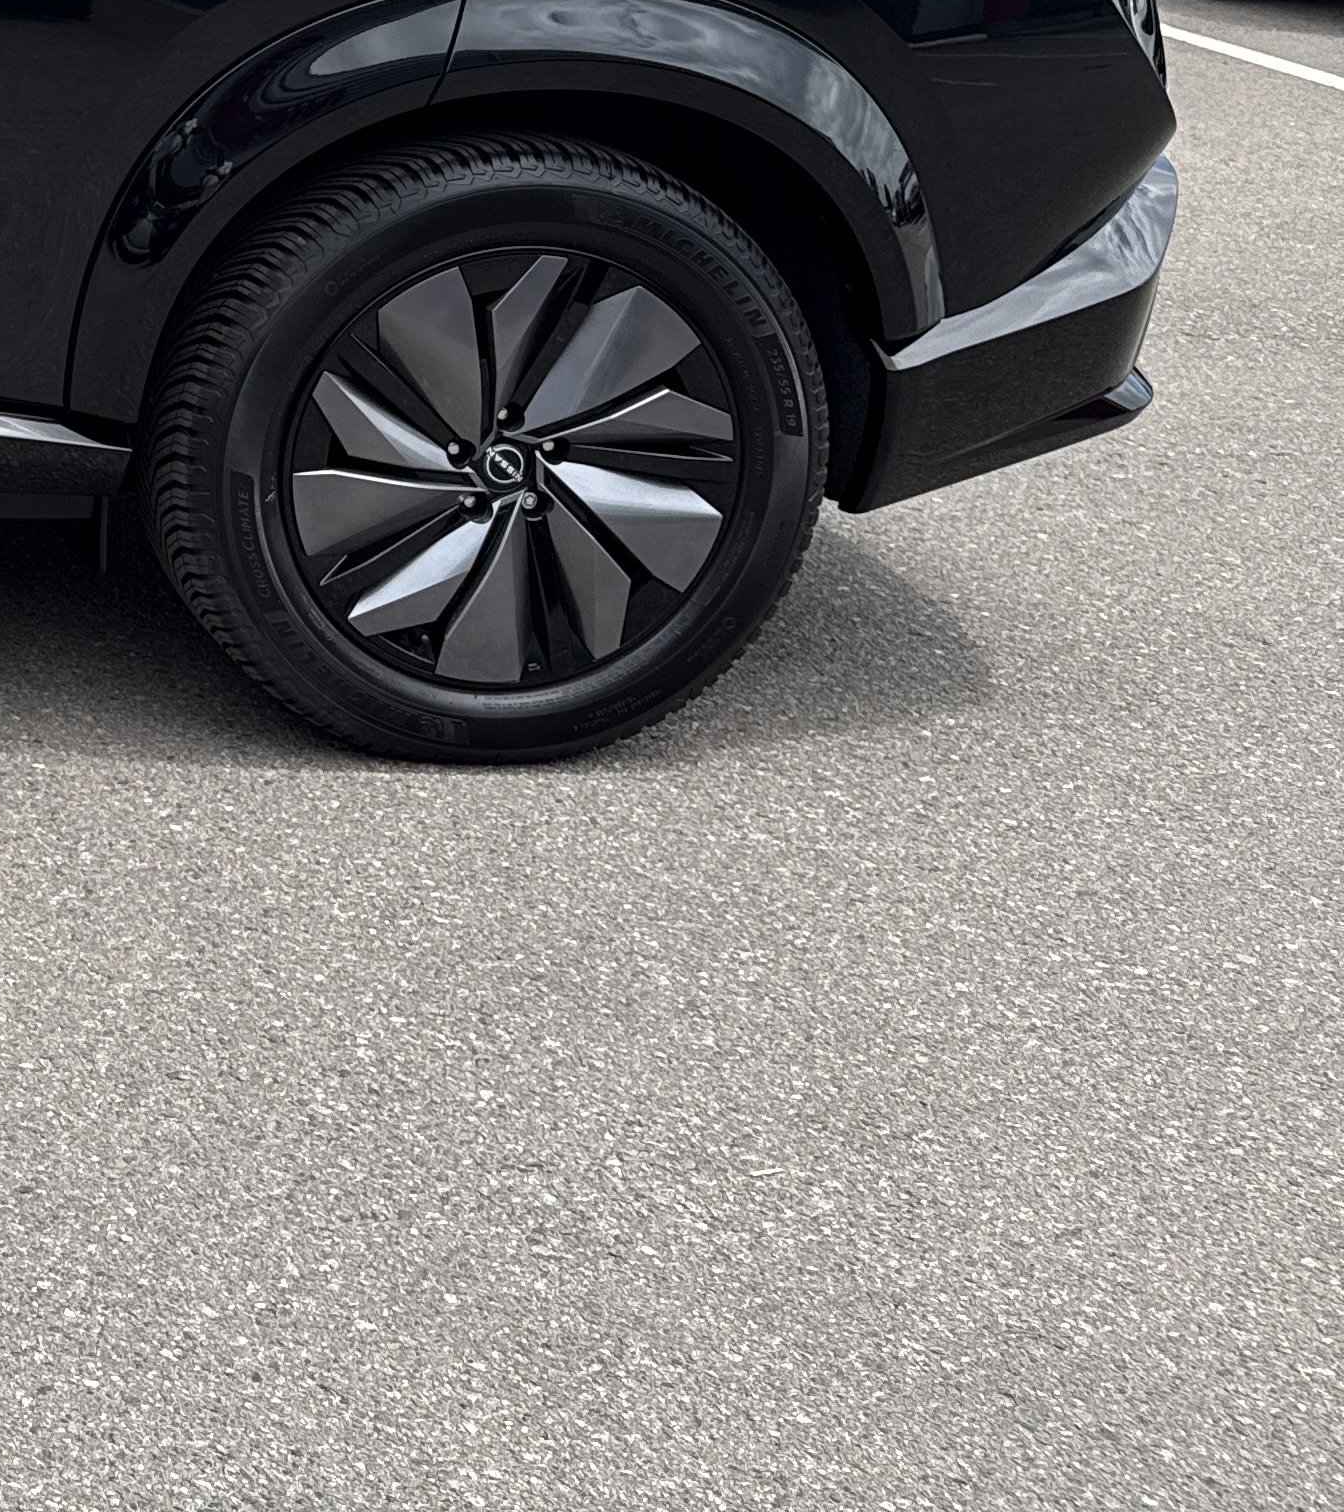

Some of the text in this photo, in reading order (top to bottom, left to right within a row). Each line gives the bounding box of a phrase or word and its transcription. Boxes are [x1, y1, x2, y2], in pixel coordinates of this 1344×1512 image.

[632, 215, 766, 328] MICHELIN
[766, 349, 793, 396] 235/55
[784, 413, 797, 427] 19
[485, 446, 524, 483] NISSAN
[238, 488, 271, 599] CROSSCLIMATE
